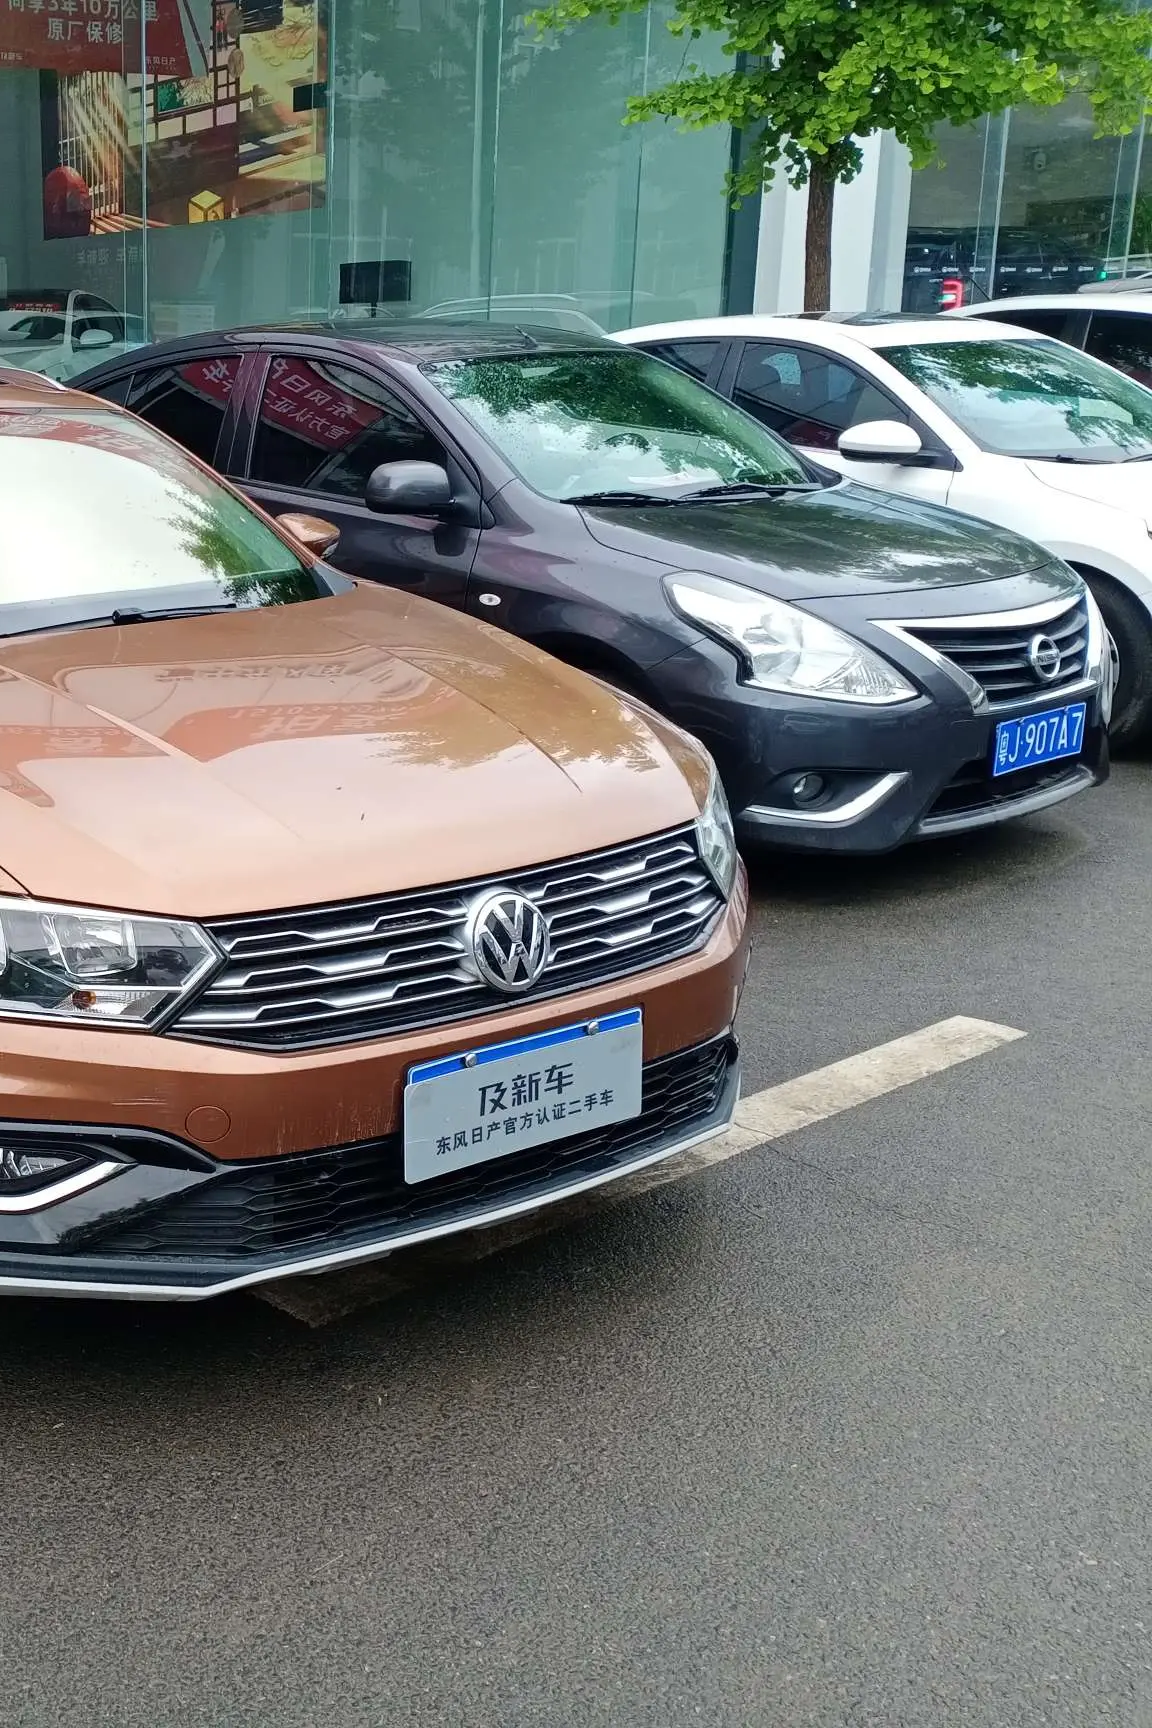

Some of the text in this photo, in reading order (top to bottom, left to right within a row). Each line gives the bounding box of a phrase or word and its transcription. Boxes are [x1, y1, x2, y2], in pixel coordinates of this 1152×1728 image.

[48, 17, 122, 45] 原厂保修
[478, 1062, 574, 1117] 及新车
[435, 1089, 615, 1156] 东风日产官方认证二手车
